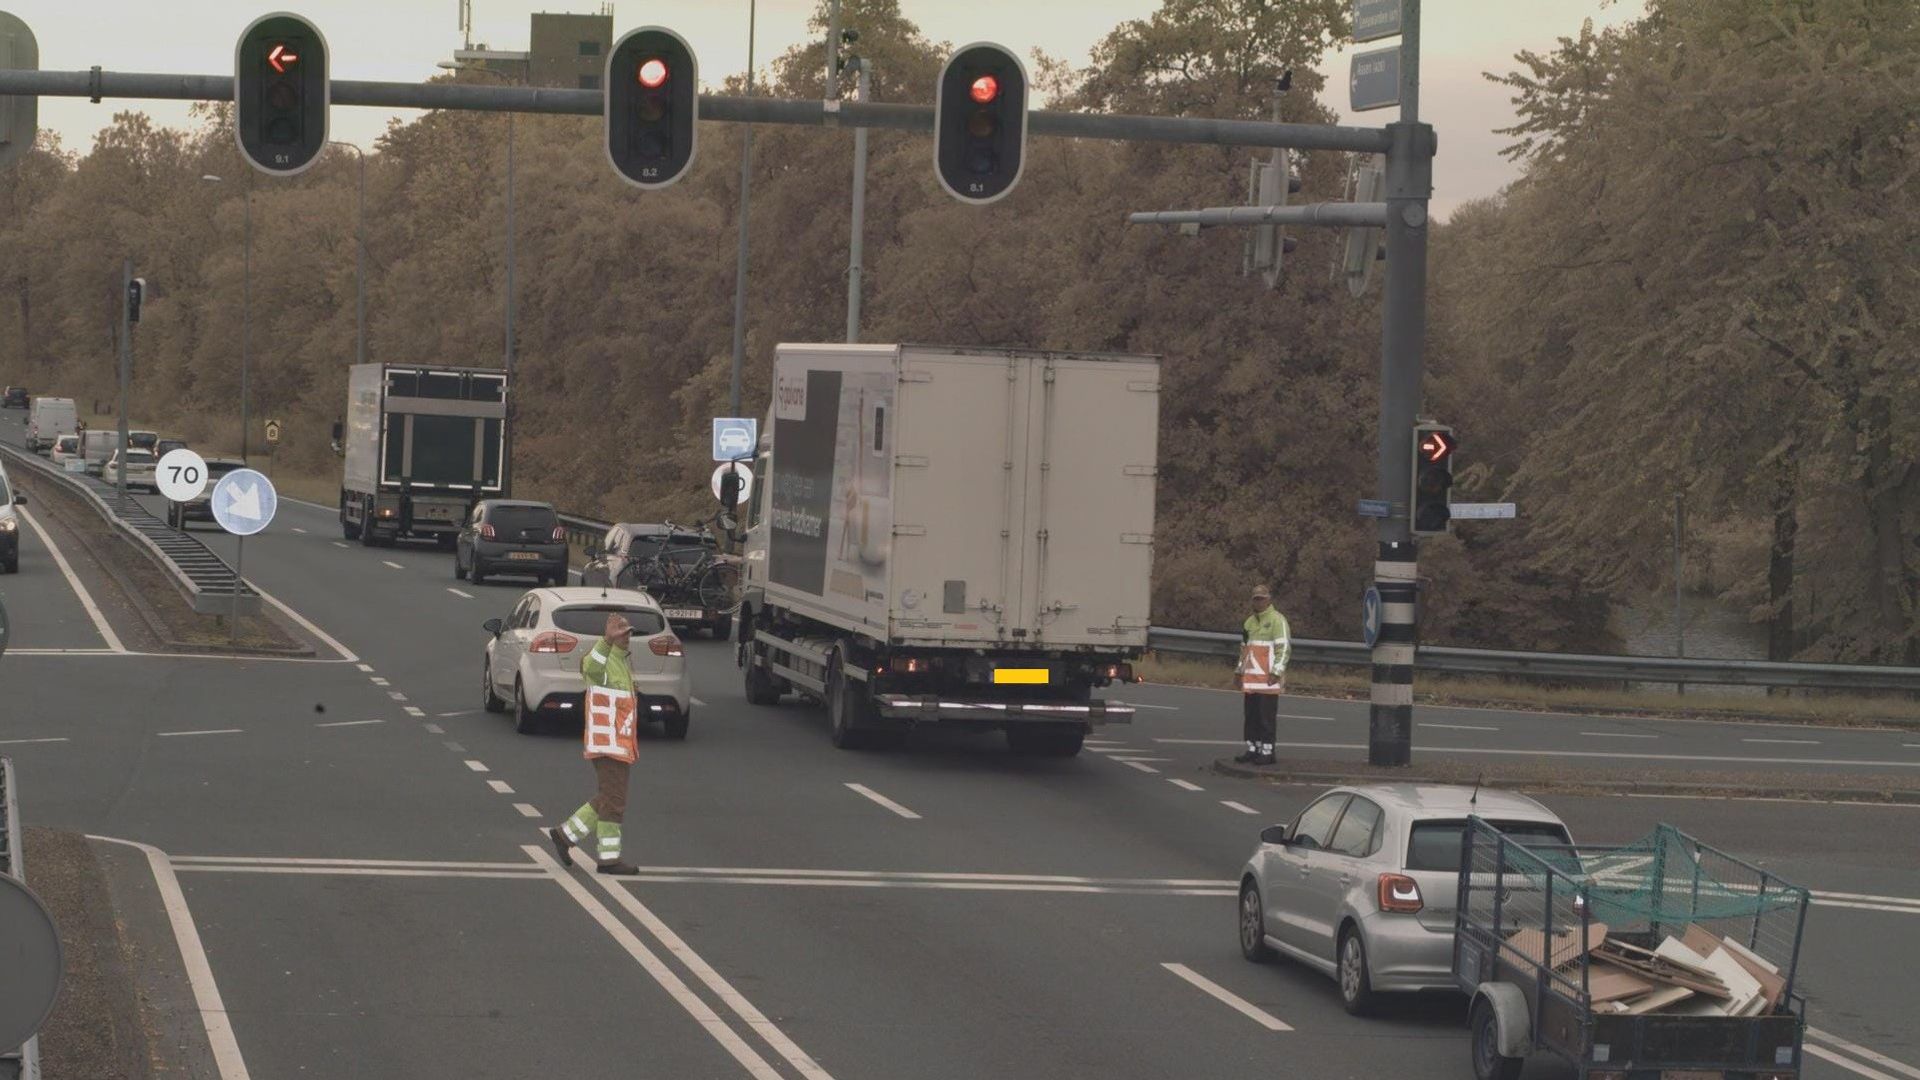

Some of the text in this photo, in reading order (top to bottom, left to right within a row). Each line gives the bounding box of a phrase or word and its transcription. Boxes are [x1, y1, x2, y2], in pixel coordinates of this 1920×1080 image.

[275, 154, 289, 164] 9.1
[969, 182, 984, 193] 8.1
[167, 466, 199, 484] 70
